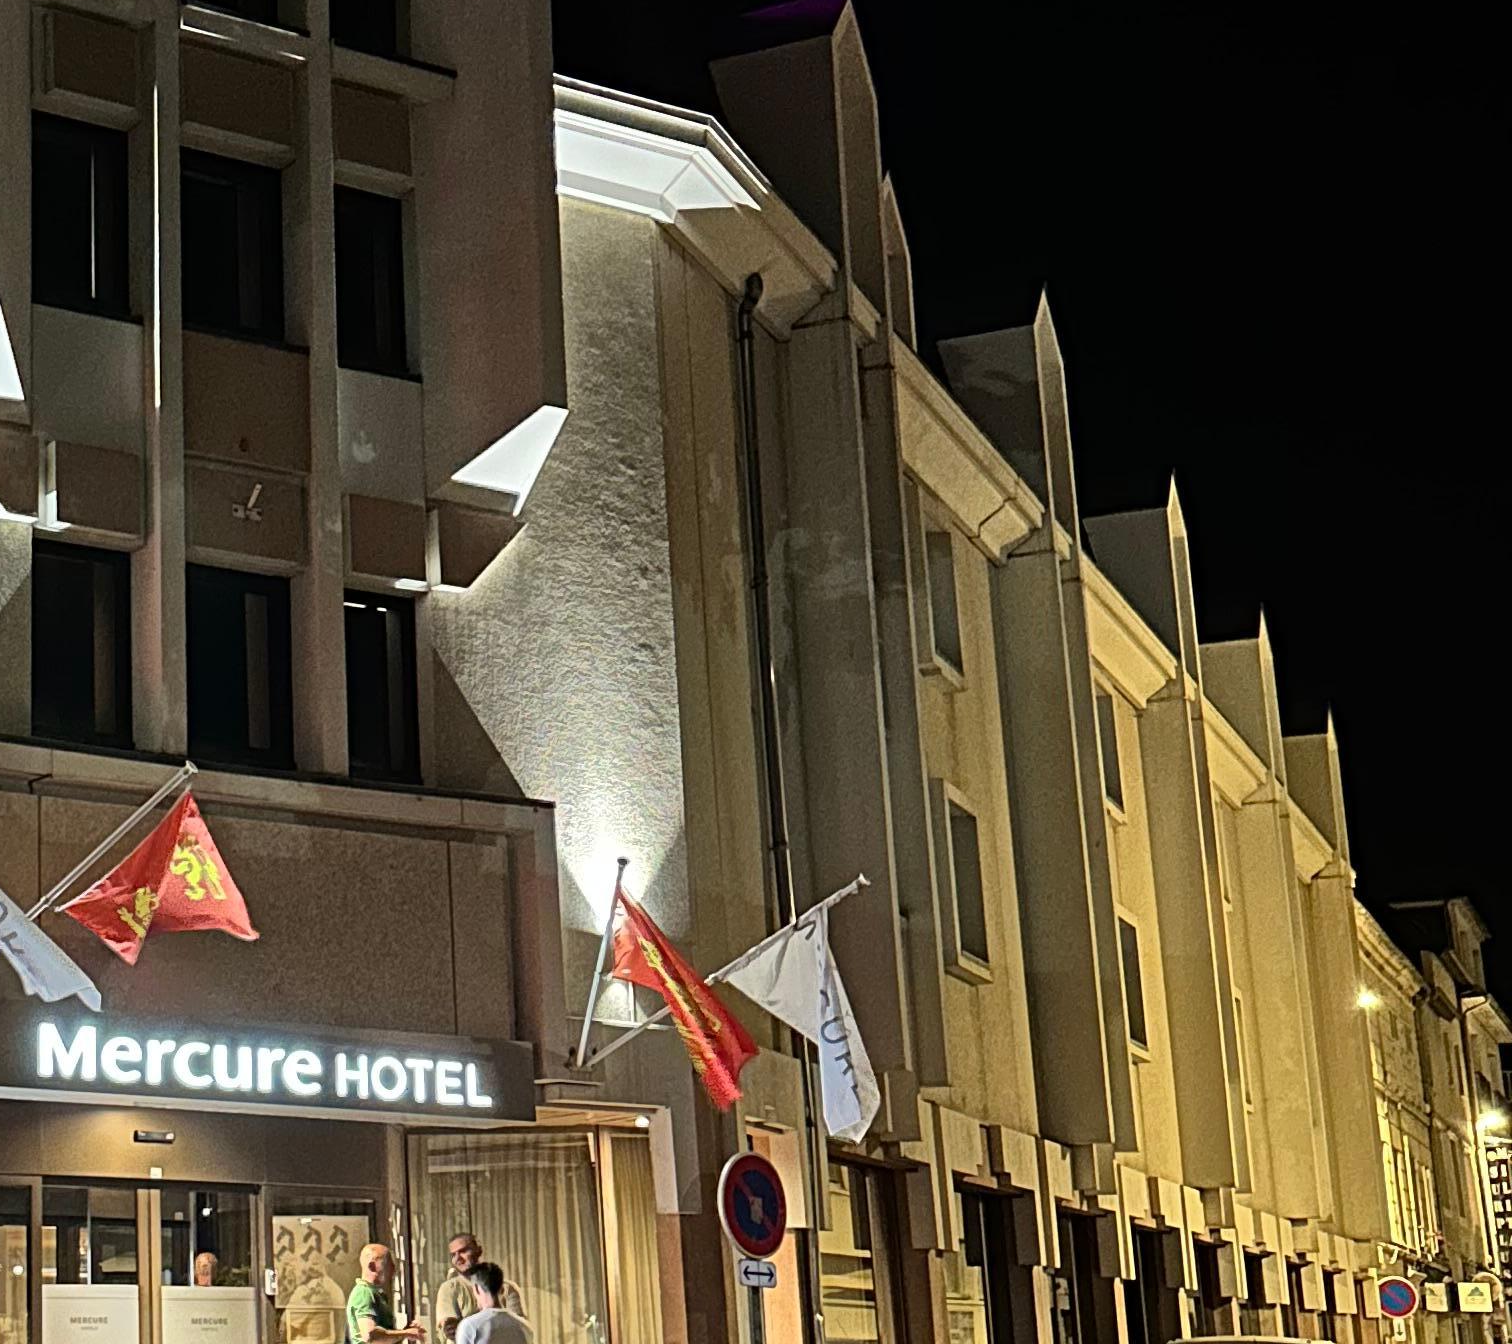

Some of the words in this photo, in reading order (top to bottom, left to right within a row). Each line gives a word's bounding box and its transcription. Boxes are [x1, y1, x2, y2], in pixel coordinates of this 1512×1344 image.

[36, 1021, 323, 1096] Mercure
[334, 1052, 493, 1108] HOTEL
[70, 1316, 108, 1324] MERCURE
[191, 1317, 229, 1325] MERCURE
